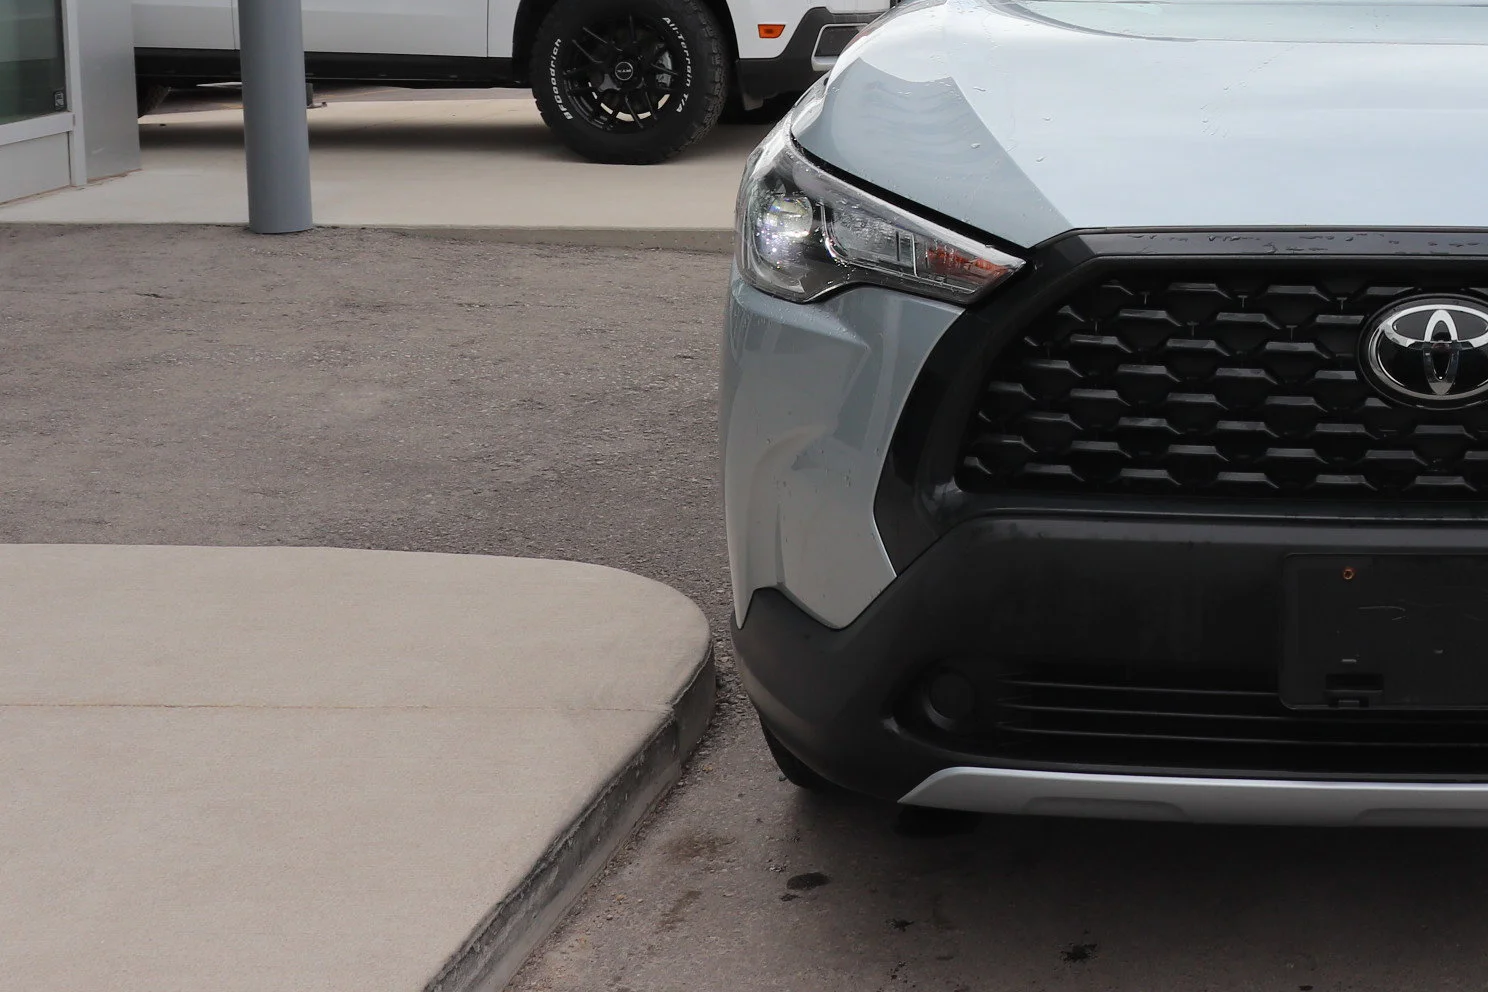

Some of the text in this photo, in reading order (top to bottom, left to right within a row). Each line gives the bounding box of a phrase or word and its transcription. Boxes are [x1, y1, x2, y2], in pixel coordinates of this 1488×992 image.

[549, 38, 574, 120] BFGoodrich
[662, 17, 692, 113] All-Terrain T/A
